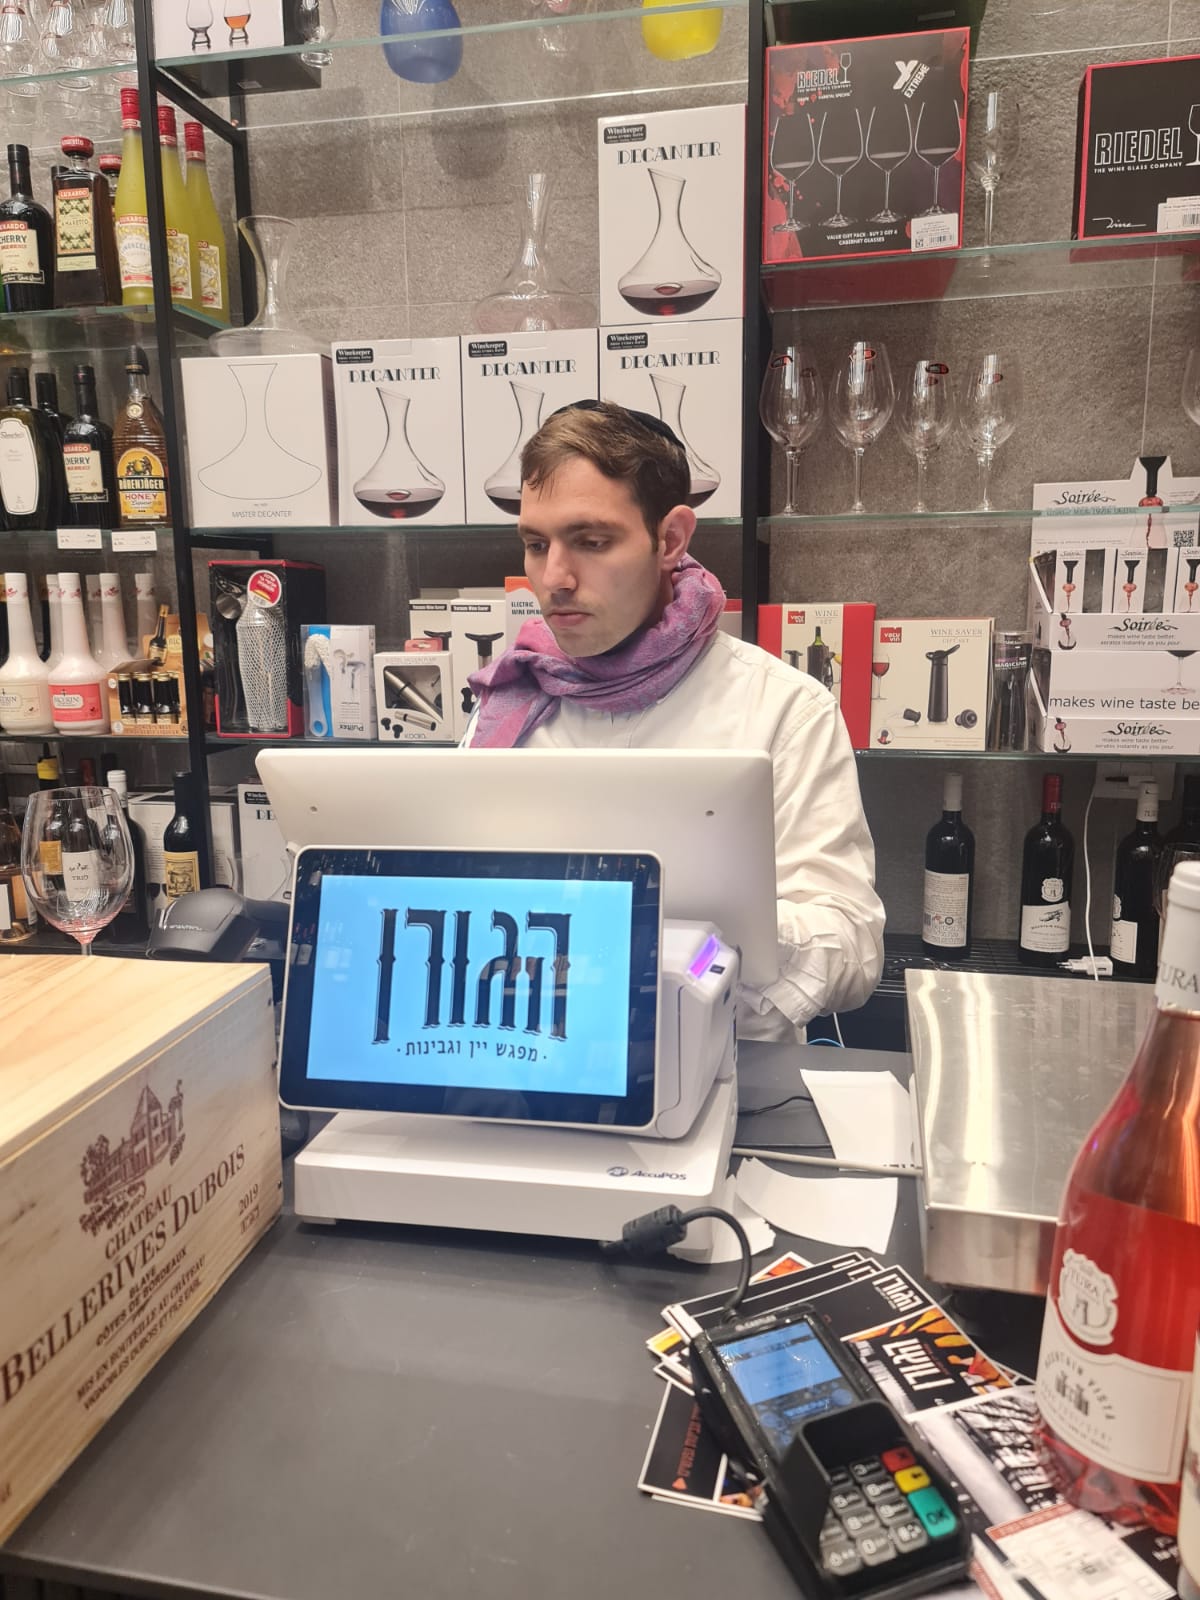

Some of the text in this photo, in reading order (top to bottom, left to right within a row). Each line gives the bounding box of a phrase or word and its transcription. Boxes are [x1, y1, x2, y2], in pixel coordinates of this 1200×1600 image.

[797, 68, 839, 89] RIEDEL
[903, 63, 930, 99] EXTREME
[617, 141, 721, 165] DECANTER
[1094, 127, 1183, 166] RIEDEL
[481, 359, 577, 376] DECANTER
[620, 350, 721, 369] DECANTER
[349, 367, 441, 383] DECANTER
[258, 510, 292, 518] DECANTER
[815, 609, 839, 617] WINE
[1049, 696, 1095, 708] makes
[1101, 697, 1135, 709] wine
[1140, 698, 1177, 710] taste
[371, 906, 572, 1045] הגורן
[405, 1040, 538, 1062] מפגש יין וגבינות
[630, 1169, 687, 1181] AccuPOS
[239, 1183, 259, 1217] 2019
[0, 1143, 246, 1407] BELLERIVES DUBOIS
[129, 1294, 142, 1314] DE
[143, 1246, 188, 1301] BORDEAUX
[129, 1264, 157, 1299] BLAYE
[926, 1507, 949, 1526] OK
